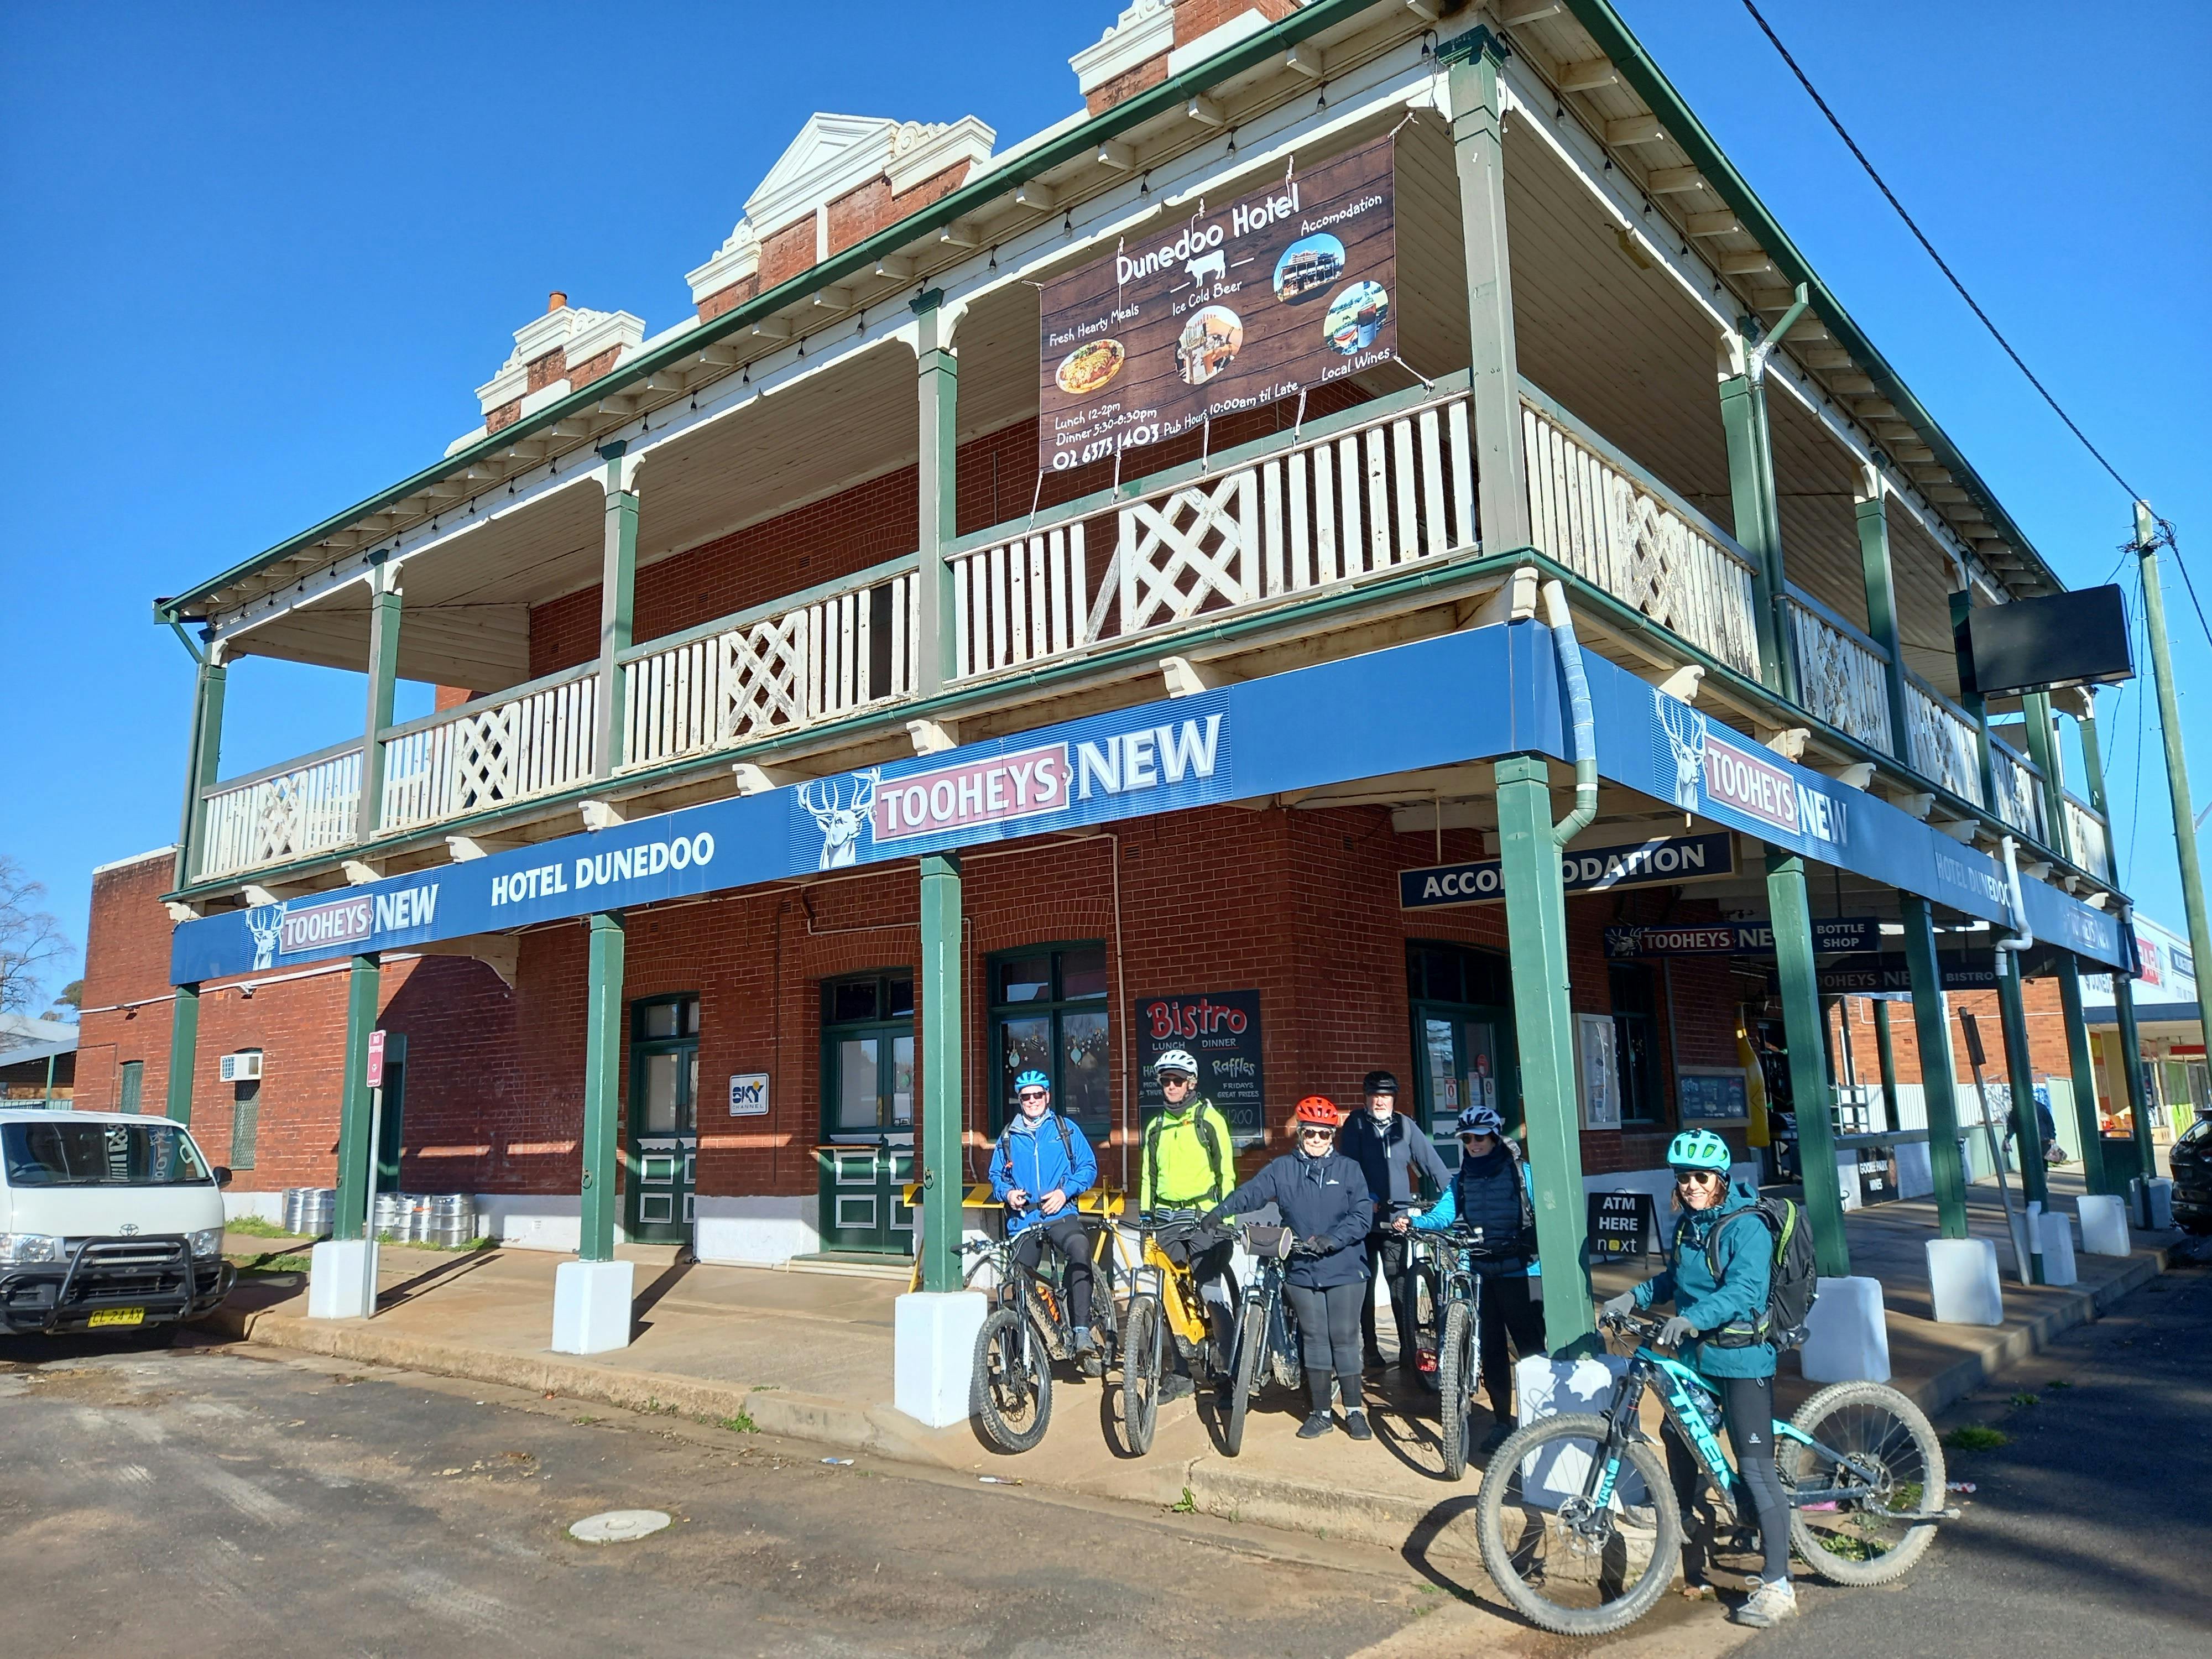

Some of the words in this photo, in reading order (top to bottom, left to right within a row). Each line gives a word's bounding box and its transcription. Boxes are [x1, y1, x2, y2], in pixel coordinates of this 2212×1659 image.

[1301, 194, 1382, 236] Accomodation
[1117, 225, 1224, 285] Dunedoo
[1232, 182, 1299, 238] Hotel
[1173, 304, 1186, 316] Ice
[1189, 290, 1209, 307] Cold
[1213, 281, 1243, 299] Beer
[1050, 328, 1074, 346] Fresh
[1078, 318, 1108, 338] Hearty
[1111, 303, 1139, 324] Meals
[1322, 360, 1350, 381] Local
[1355, 348, 1390, 372] Wines
[1055, 411, 1086, 430] Lunch
[1088, 403, 1120, 420] 12-2pm
[1164, 420, 1181, 436] Pub
[1185, 409, 1207, 429] Hours
[1210, 397, 1256, 415] 10:00am
[1259, 387, 1271, 403] til
[1275, 382, 1298, 397] Late
[1056, 429, 1092, 446] Dinner
[1093, 409, 1157, 436] 5:30-8:30pm
[1053, 450, 1078, 470] 02
[1082, 437, 1113, 463] 6375
[1118, 424, 1160, 450] 1403
[881, 757, 1056, 831] TOOHEYS
[1077, 713, 1224, 800] NEW
[1708, 746, 1796, 822] TOOHEYS
[1797, 782, 1848, 846] NEW
[491, 863, 568, 907] HOTEL
[575, 832, 715, 890] DUNEDOO
[1422, 844, 1705, 899] ACCOODATION
[1935, 852, 1968, 889] HOTEL
[284, 904, 370, 947] TOOHEYS
[373, 883, 440, 933] NEW
[1817, 924, 1865, 935] BOTTLE
[1645, 928, 1730, 949] TOOHEYS
[1739, 928, 1774, 948] NE
[1823, 938, 1859, 948] SHOP
[1817, 974, 1877, 987] OHEYS
[1884, 971, 1911, 986] NE
[1946, 972, 1995, 982] BISTRO
[1147, 997, 1248, 1040] Bistro
[1152, 1041, 1185, 1051] LUNCH
[1202, 1038, 1237, 1048] DINNER
[1212, 1057, 1255, 1078] Raffles
[733, 1084, 764, 1103] SKY
[1603, 1197, 1635, 1211] ATM
[1599, 1217, 1638, 1232] HERE
[1597, 1238, 1637, 1253] next
[110, 1310, 125, 1321] 24
[128, 1308, 142, 1320] AX
[1669, 1386, 1730, 1491] TREK
